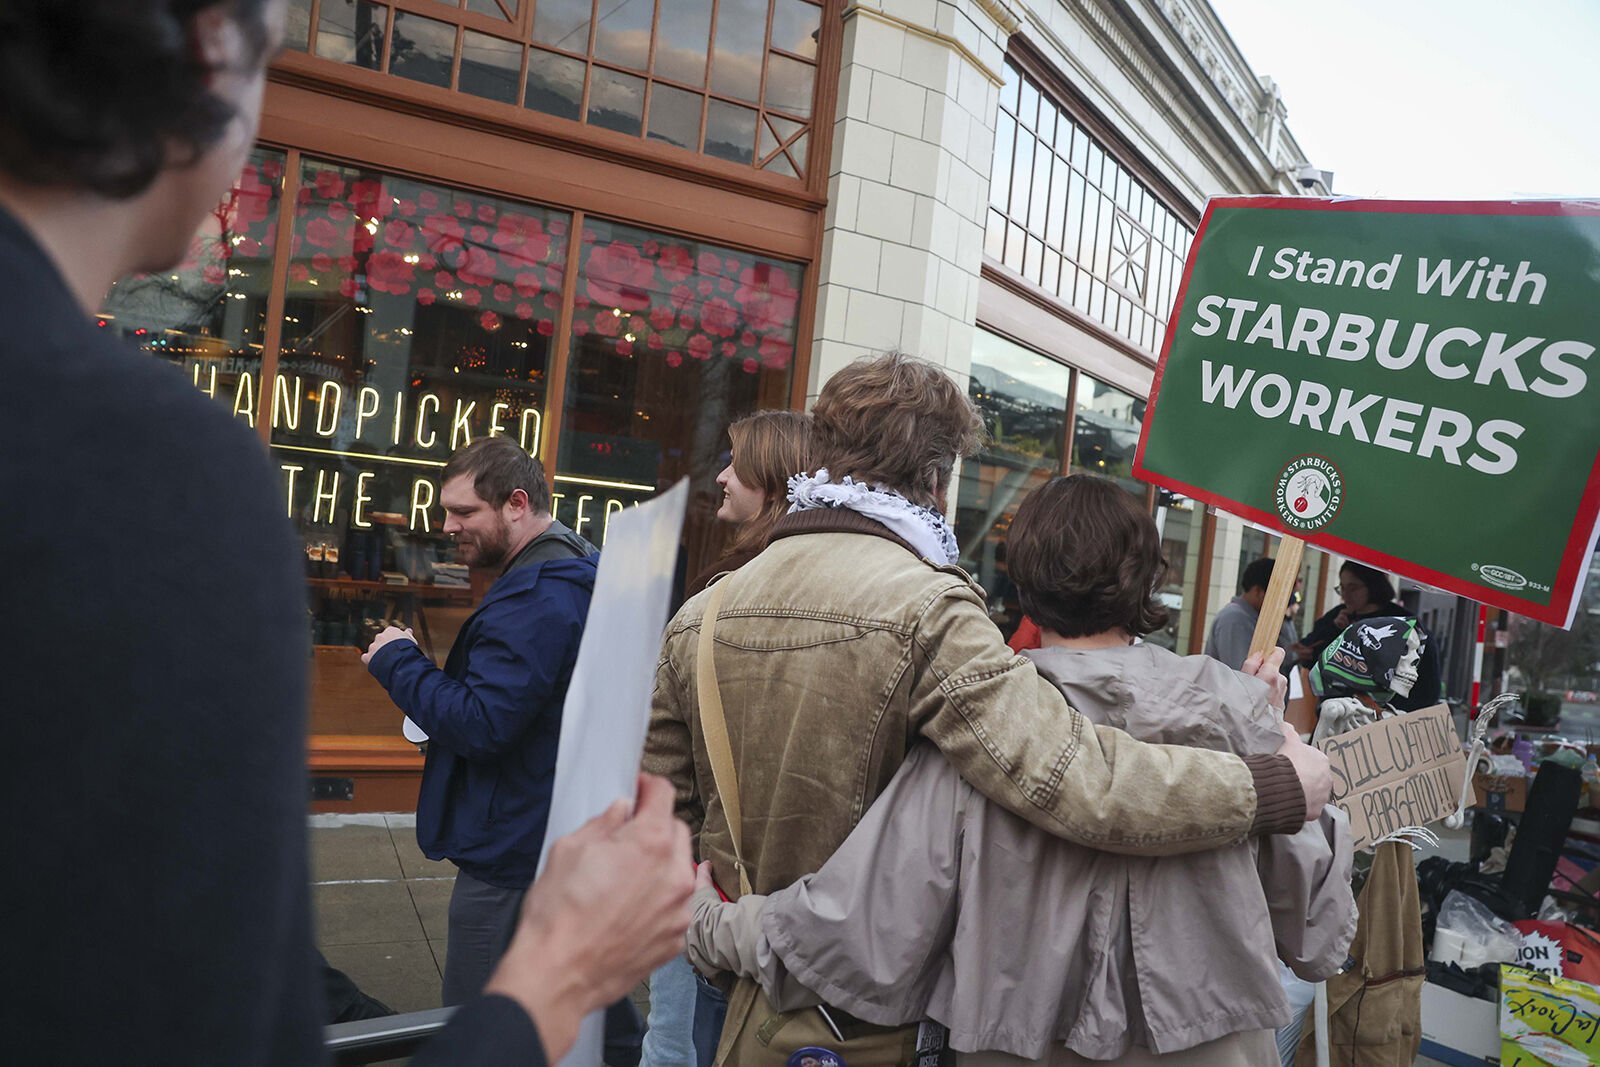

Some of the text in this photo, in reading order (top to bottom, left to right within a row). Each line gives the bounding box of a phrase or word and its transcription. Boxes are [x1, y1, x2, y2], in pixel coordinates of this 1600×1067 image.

[1247, 245, 1547, 305] I Stand With
[1191, 294, 1596, 398] STARBUCKS
[1201, 359, 1526, 475] WORKERS
[281, 465, 375, 527] THE
[1287, 457, 1341, 488] STARBUCKS
[1276, 478, 1340, 530] WORKERS UNITED
[1323, 731, 1394, 801] STILL
